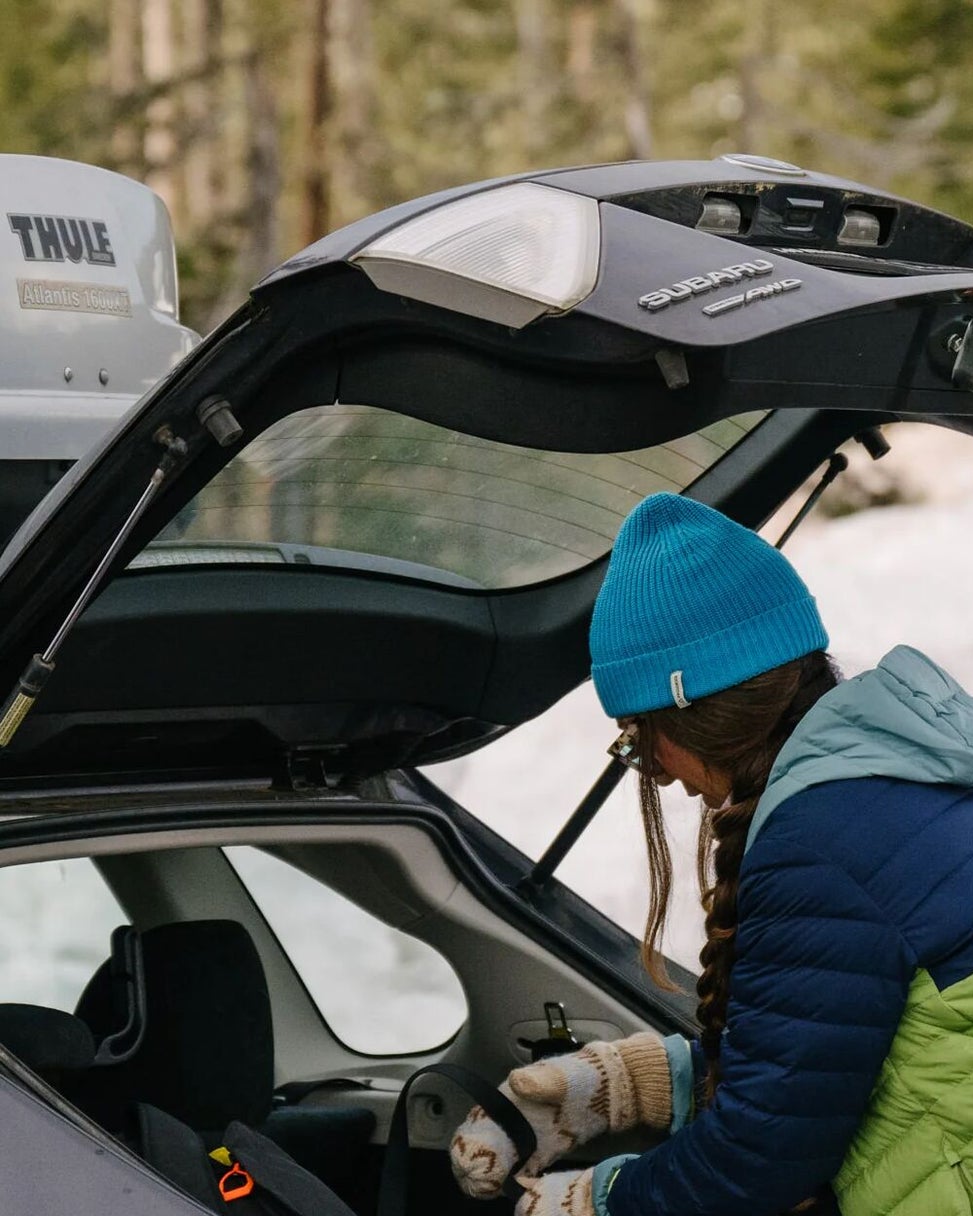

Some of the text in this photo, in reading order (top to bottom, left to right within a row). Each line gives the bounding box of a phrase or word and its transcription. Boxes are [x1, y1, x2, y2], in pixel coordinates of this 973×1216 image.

[9, 214, 116, 265] THULE
[23, 282, 80, 307] Atlantis
[638, 259, 774, 310] SUBARU
[745, 278, 802, 304] AWD
